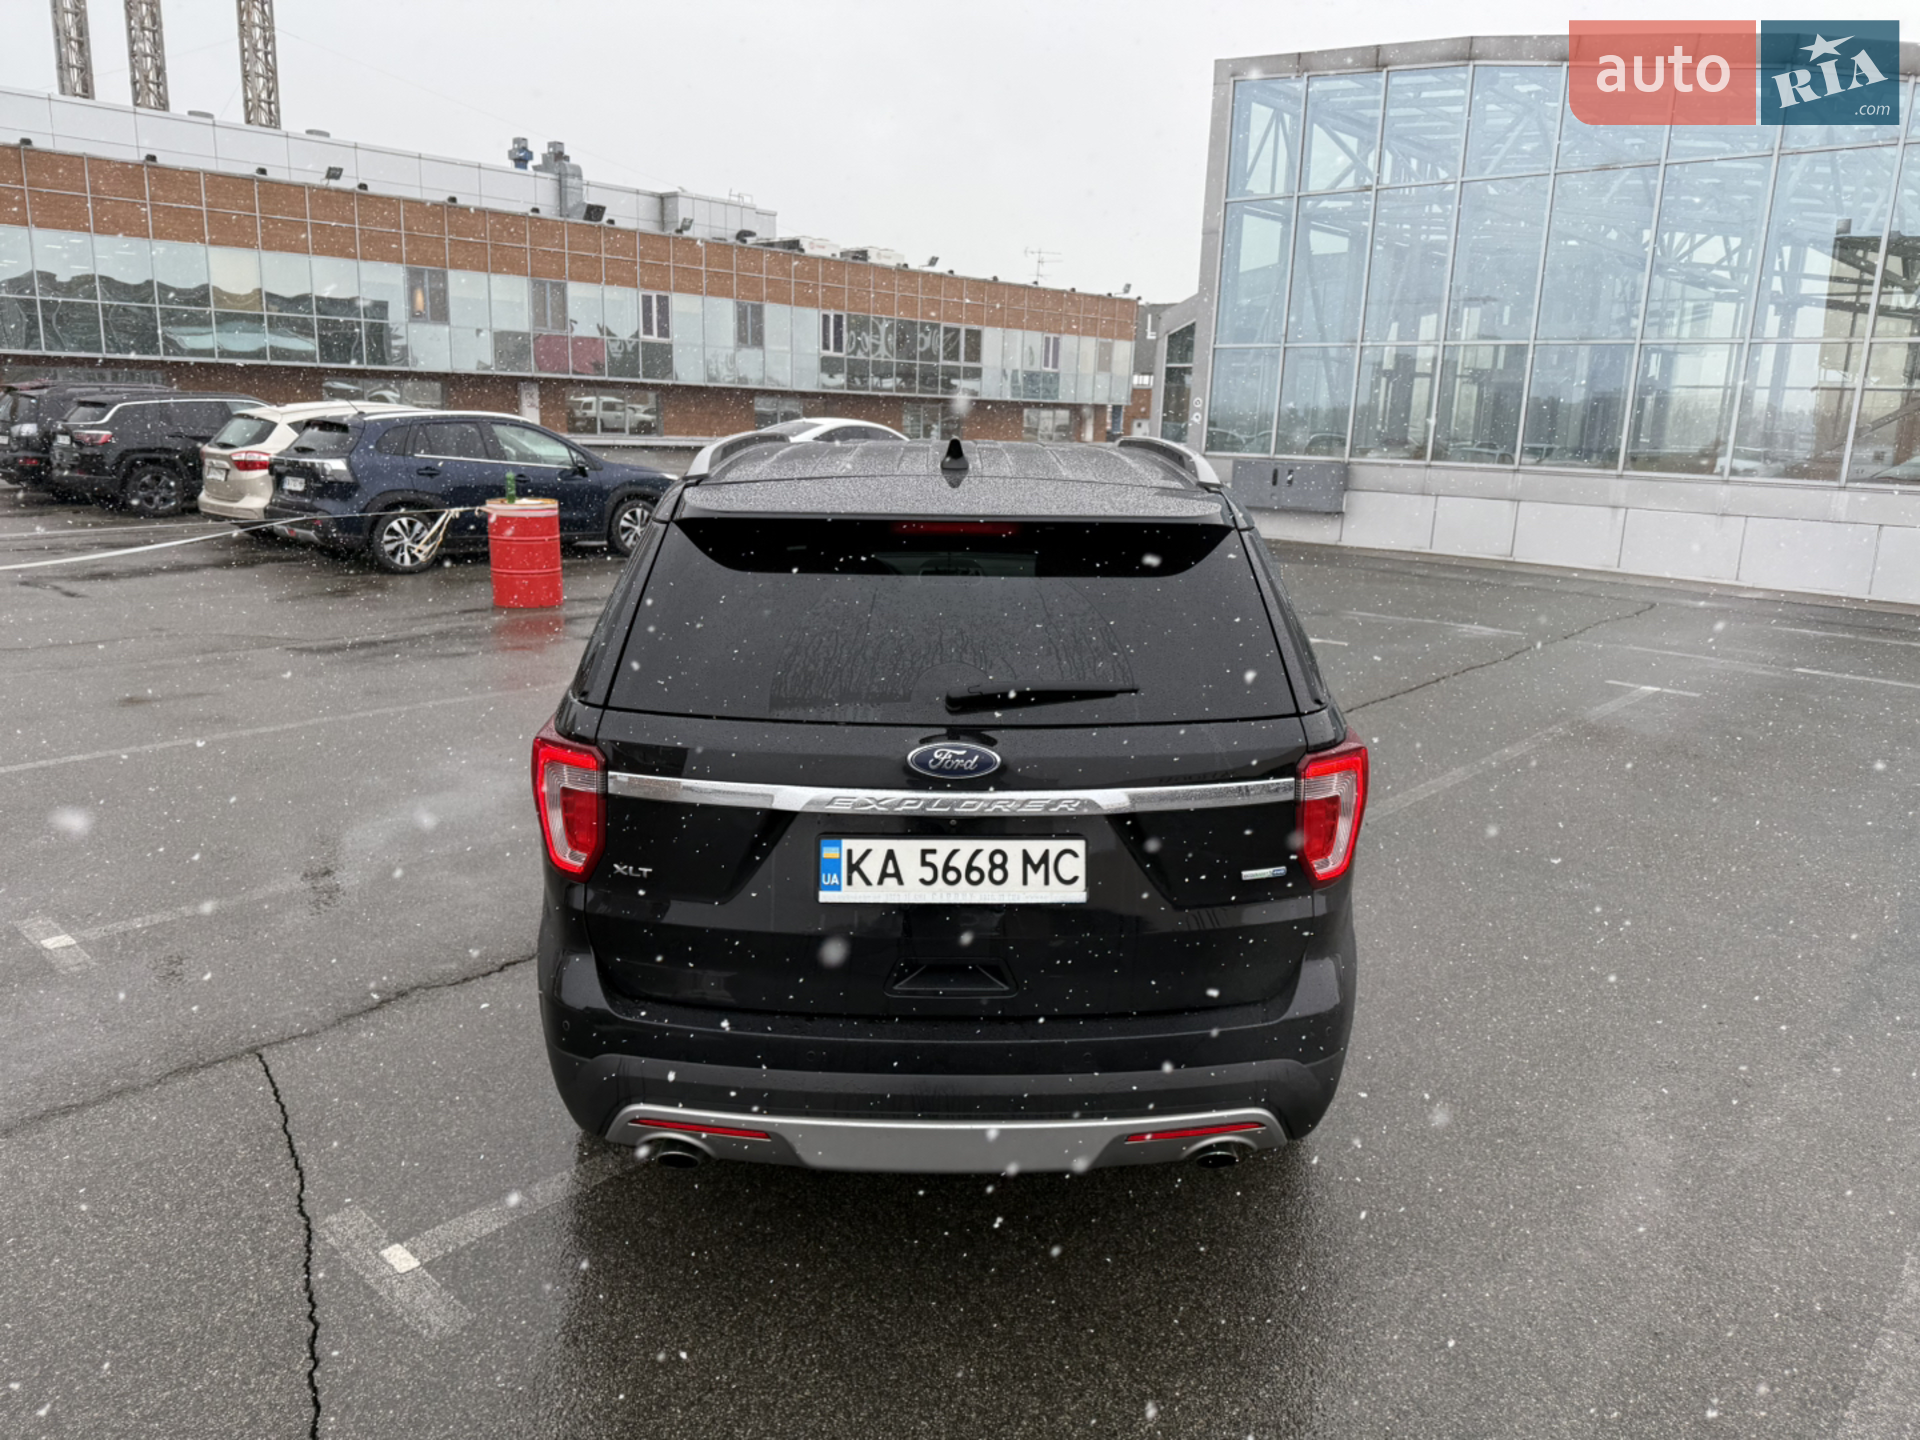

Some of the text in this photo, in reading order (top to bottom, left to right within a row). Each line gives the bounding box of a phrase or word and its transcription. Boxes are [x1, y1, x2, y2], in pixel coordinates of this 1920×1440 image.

[929, 749, 978, 771] Ford
[825, 796, 1081, 812] EXPLORER
[613, 863, 653, 879] XLT
[846, 848, 1080, 886] KA 5668 MC
[822, 874, 840, 885] UA
